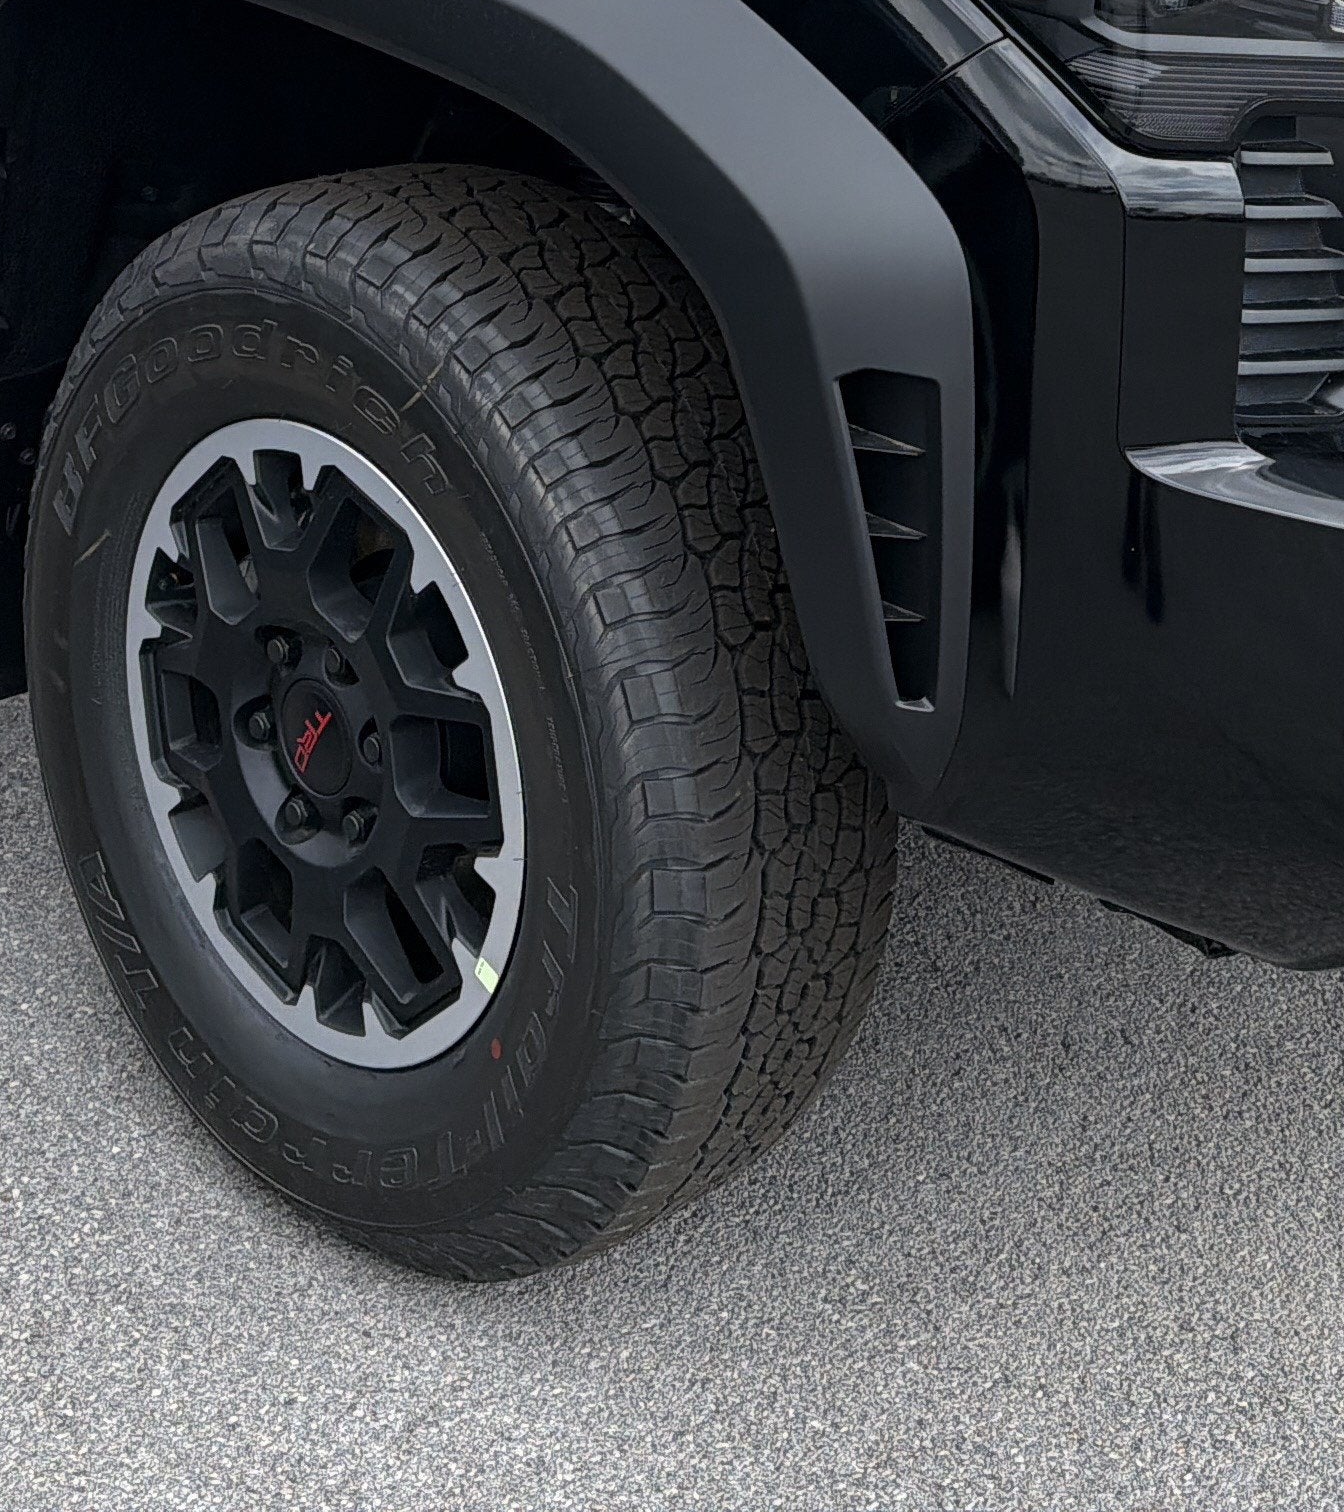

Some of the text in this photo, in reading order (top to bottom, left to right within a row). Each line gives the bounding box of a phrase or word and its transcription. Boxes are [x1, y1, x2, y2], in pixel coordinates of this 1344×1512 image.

[53, 318, 453, 535] BFGoodrich
[294, 710, 333, 774] TRD
[78, 850, 160, 1014] T/A
